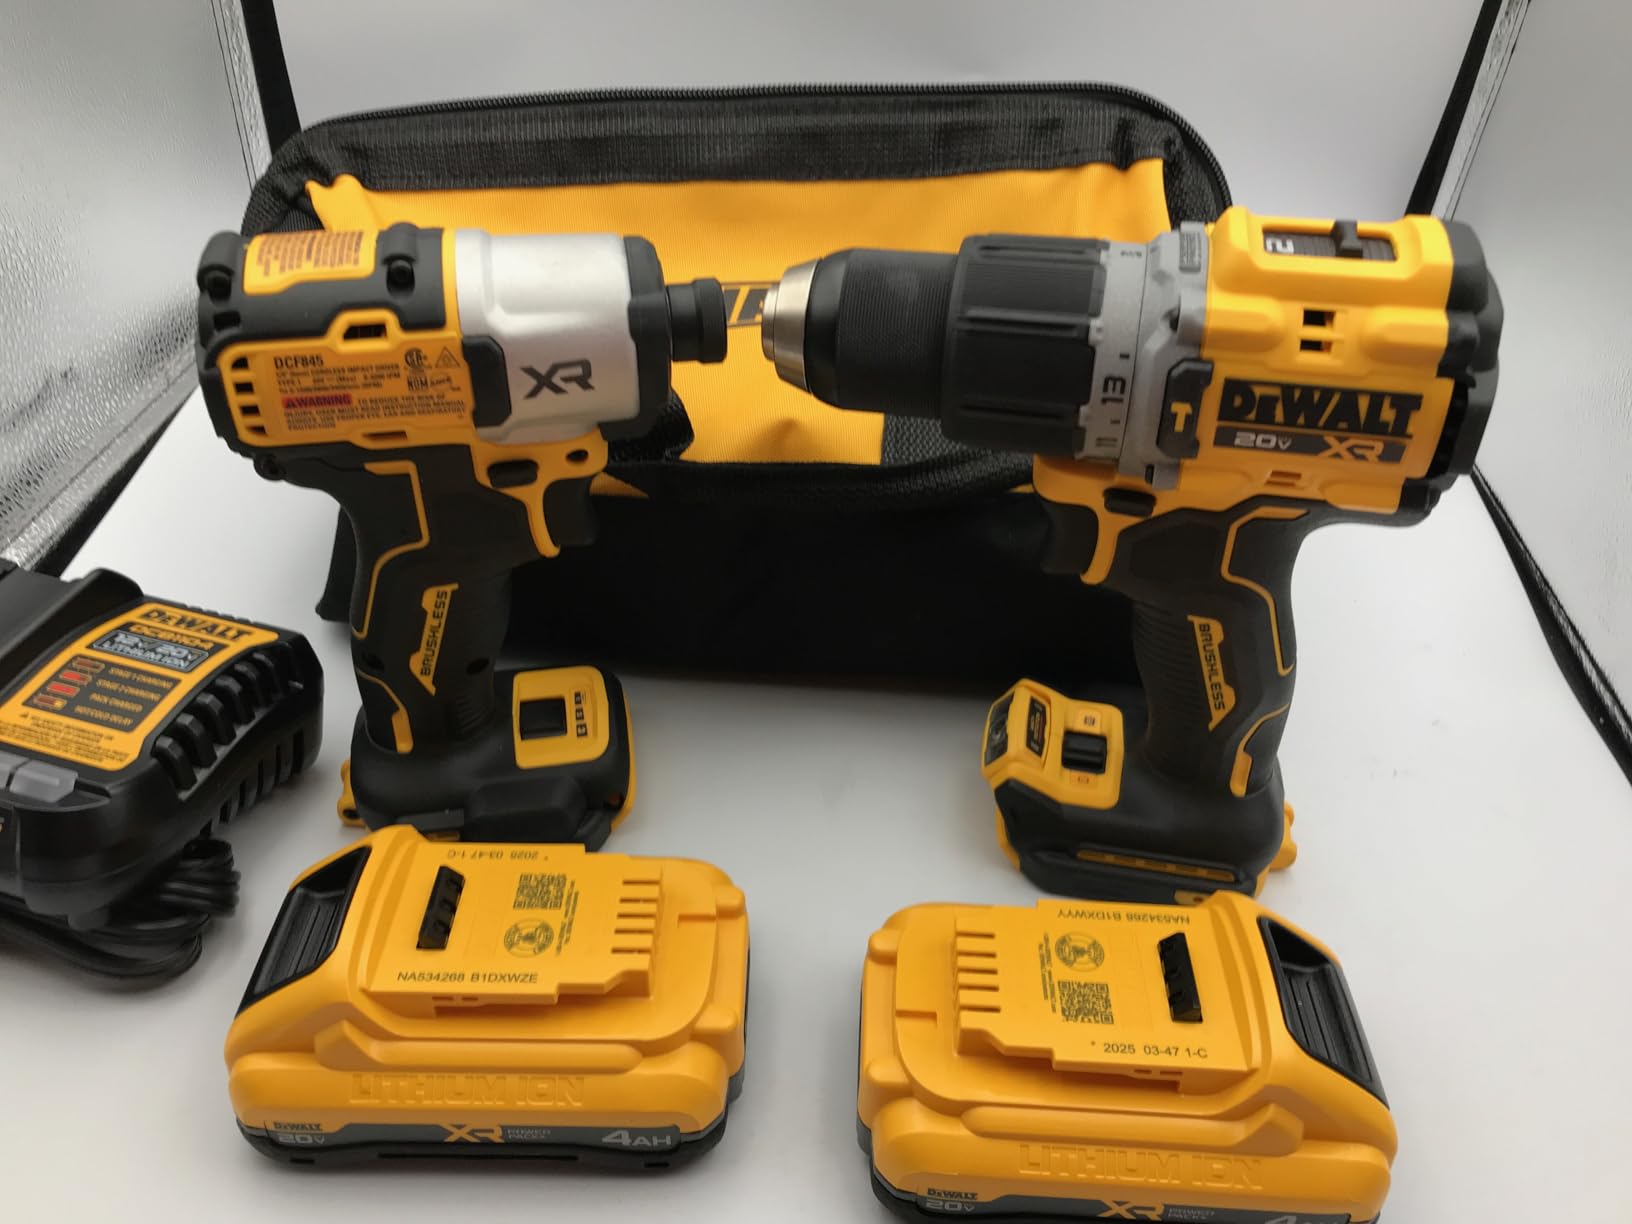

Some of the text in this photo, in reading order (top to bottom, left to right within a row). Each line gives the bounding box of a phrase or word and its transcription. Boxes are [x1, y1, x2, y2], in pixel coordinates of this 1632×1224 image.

[274, 353, 324, 371] DCF845
[520, 358, 595, 400] XR
[1102, 376, 1126, 404] 13
[1217, 378, 1424, 439] DEWALT
[1317, 434, 1385, 462] XR
[420, 590, 448, 677] BRUSHLESS
[1199, 623, 1226, 711] BRUSHLESS
[397, 971, 538, 984] NA534268 B1DXWZE
[1103, 1042, 1136, 1055] 2025
[1143, 1044, 1179, 1058] 03-47
[349, 1072, 585, 1107] LITHIUM ION
[441, 1123, 505, 1143] XR
[602, 1129, 672, 1147] 4AH
[1018, 1143, 1264, 1191] LITHIUM ION
[1097, 1199, 1165, 1222] XR
